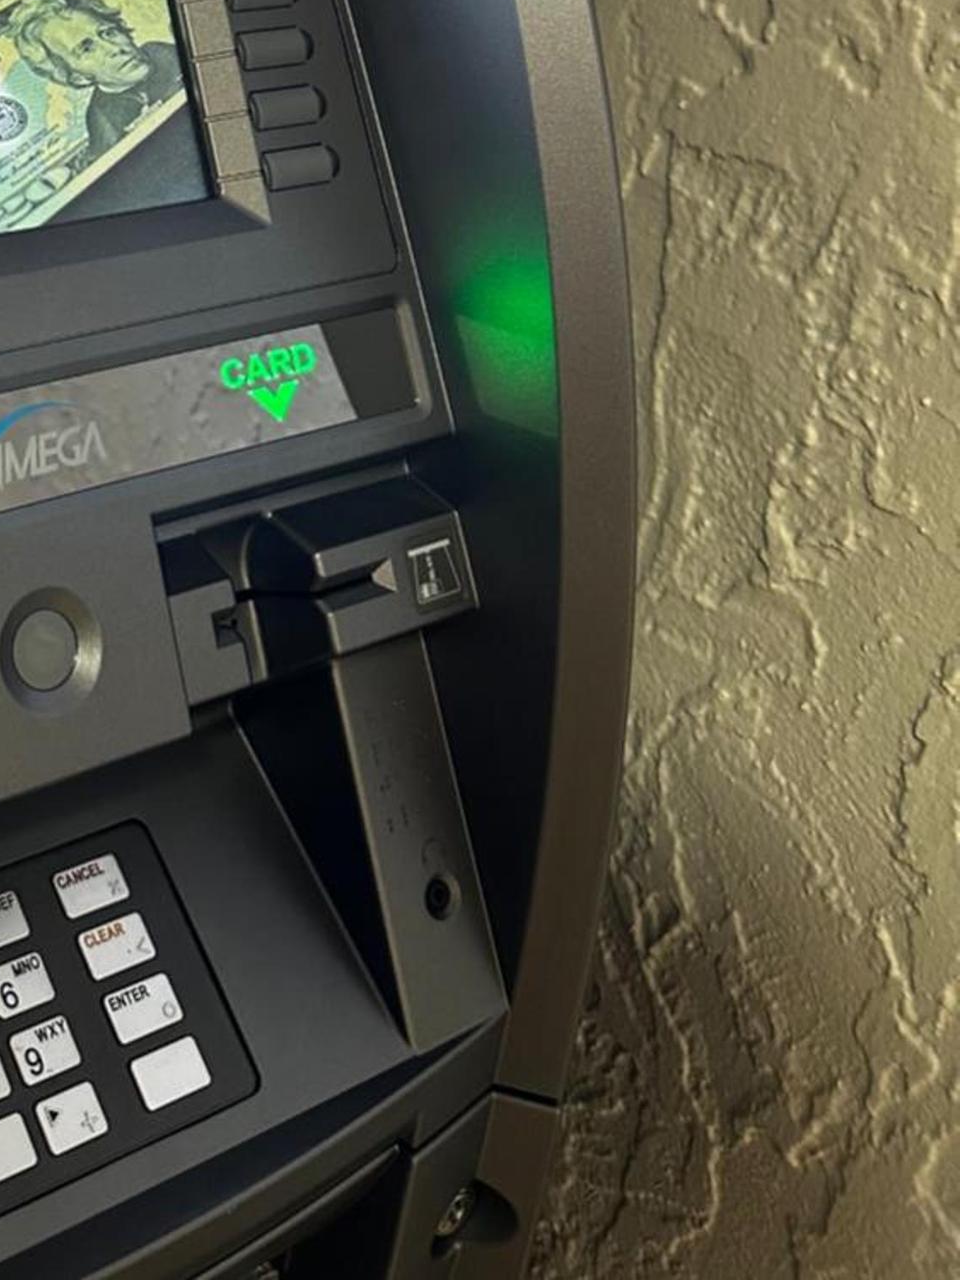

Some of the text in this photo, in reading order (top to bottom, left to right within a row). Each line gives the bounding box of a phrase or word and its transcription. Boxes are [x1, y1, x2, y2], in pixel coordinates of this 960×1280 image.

[220, 342, 317, 389] CARD
[56, 862, 105, 889] CANCEL
[83, 922, 126, 948] CLEAR
[10, 955, 40, 978] MNO
[0, 981, 20, 1009] 6
[108, 984, 151, 1013] ENTER
[34, 1019, 67, 1044] WXY
[24, 1047, 45, 1077] 9
